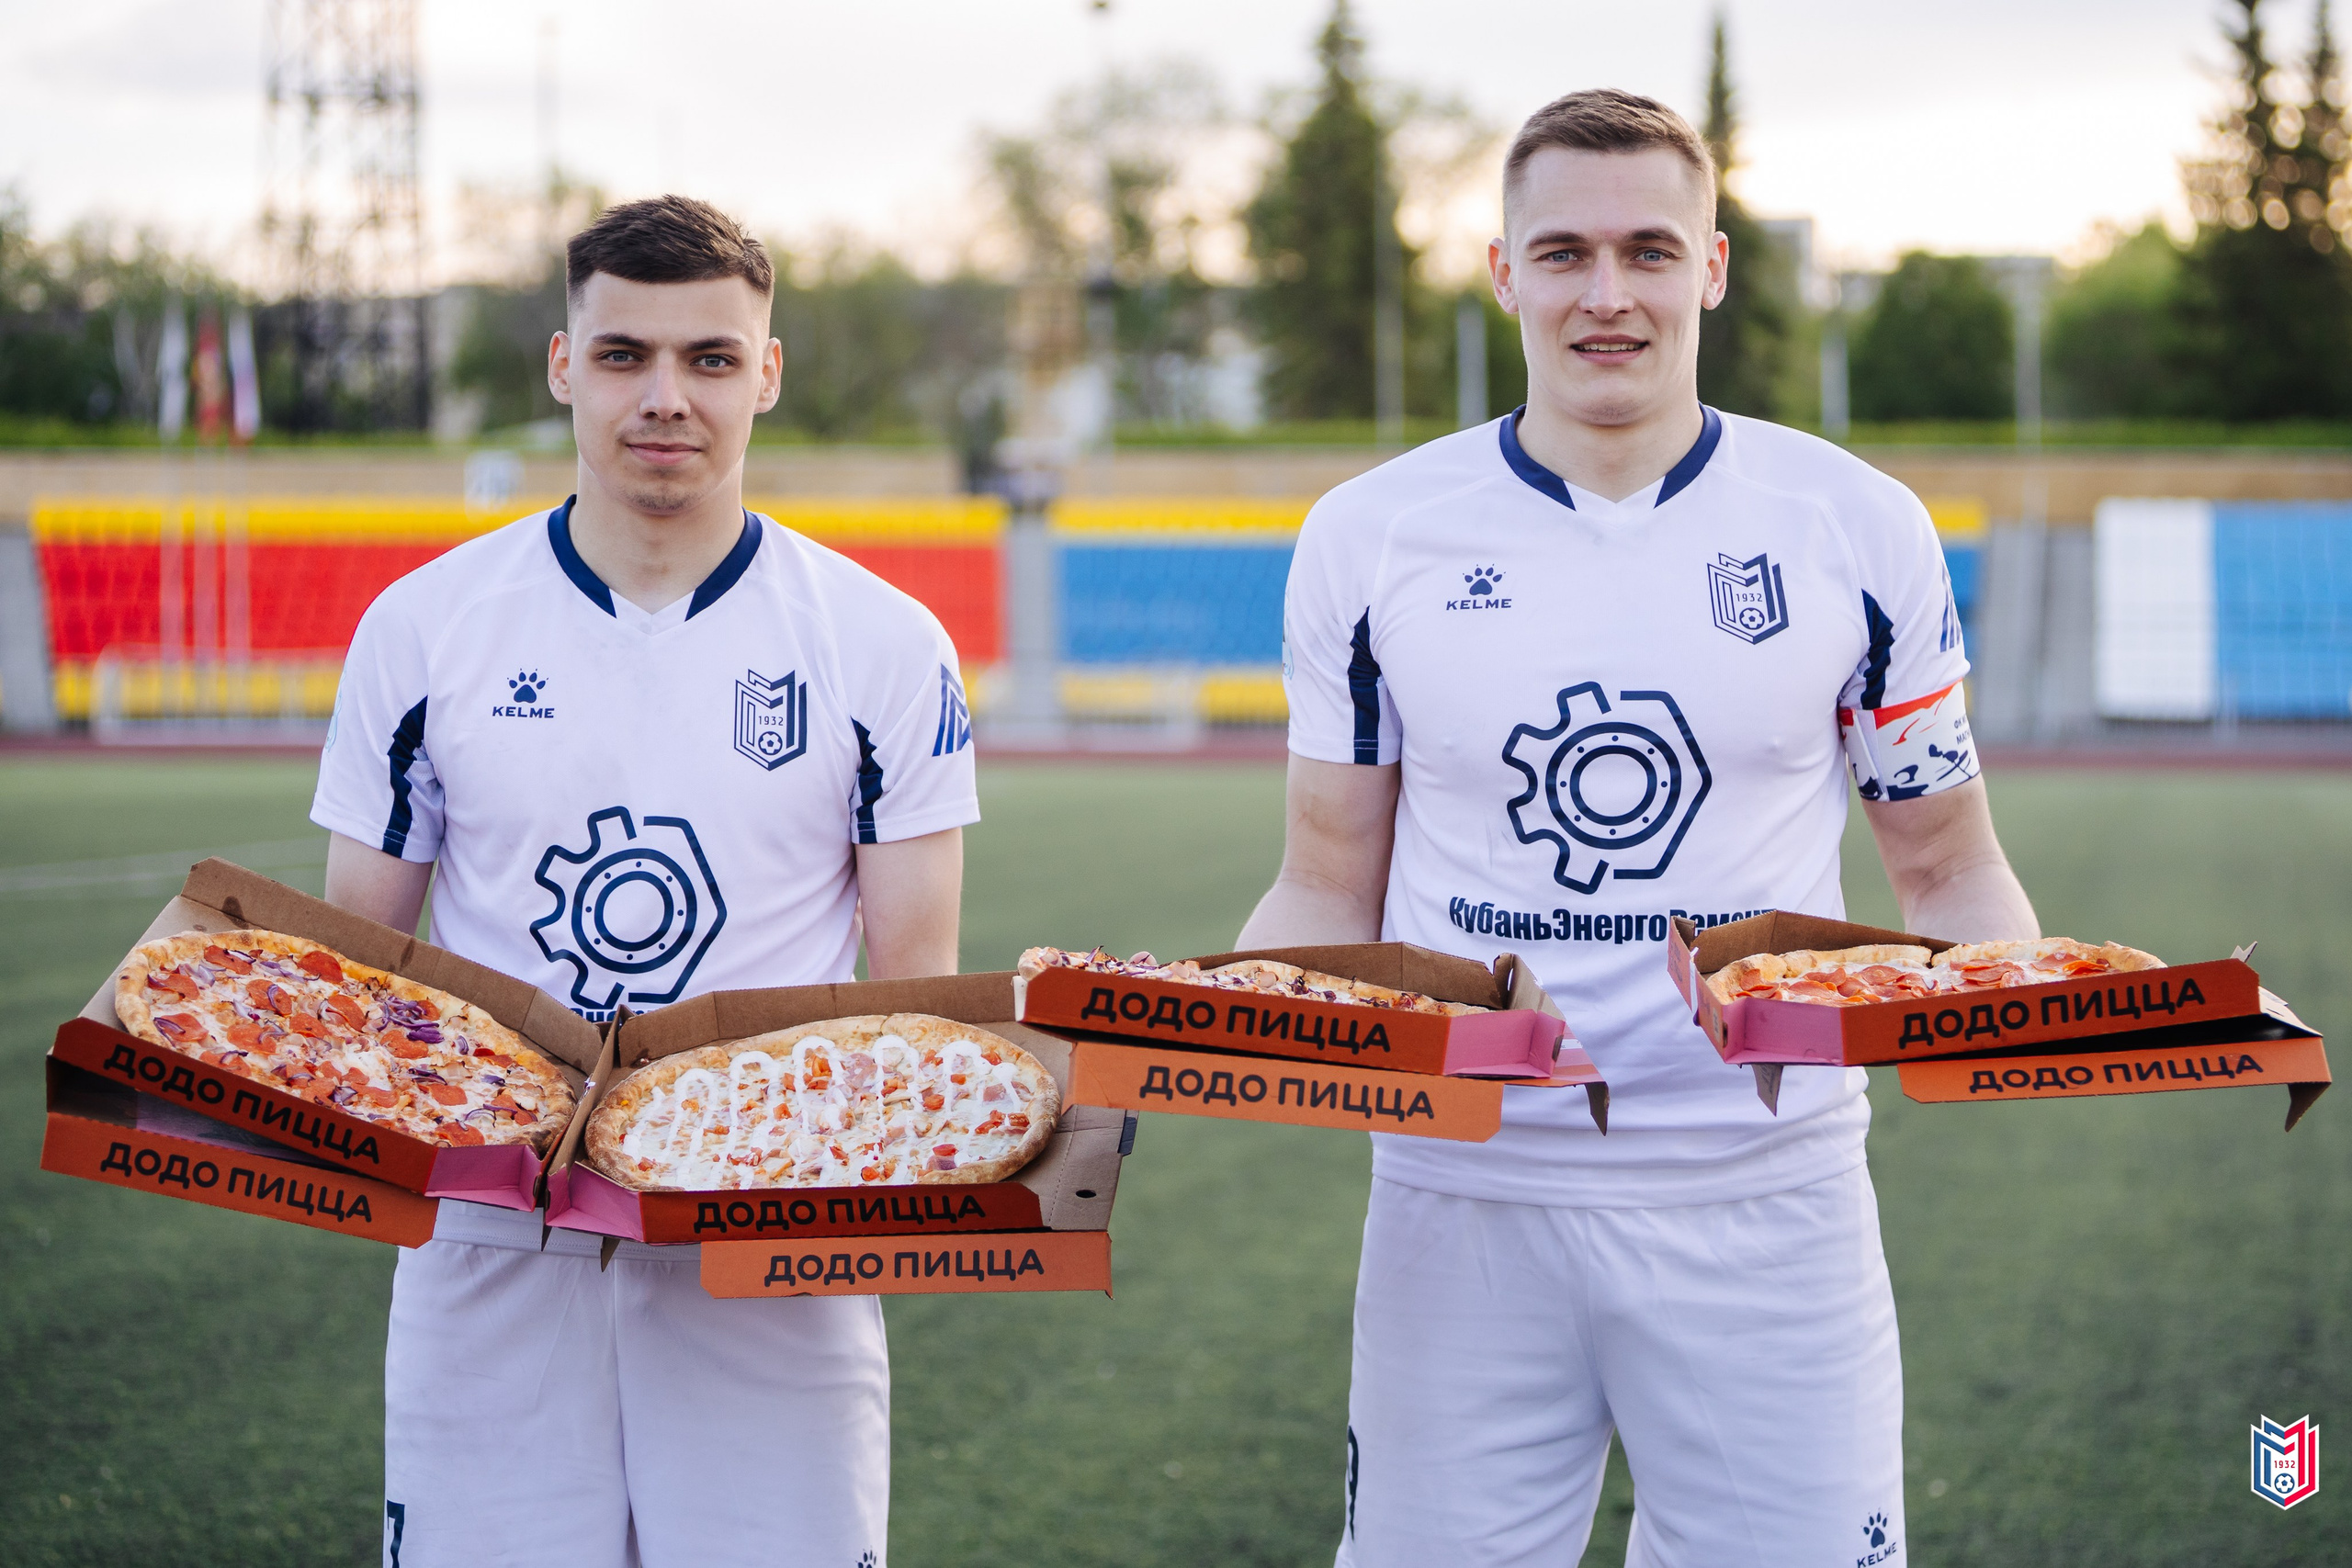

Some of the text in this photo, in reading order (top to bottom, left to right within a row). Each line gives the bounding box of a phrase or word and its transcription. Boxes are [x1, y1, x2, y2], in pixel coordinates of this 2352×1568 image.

[1445, 598, 1512, 611] KELME
[1736, 592, 1763, 603] 1932
[492, 705, 555, 719] KELME
[758, 716, 784, 727] 1932
[1081, 987, 1391, 1055] ДОДО ПИЦЦА
[1899, 977, 2205, 1049] ДОДО ПИЦЦА
[1970, 1055, 2263, 1093] ДОДО ПИЦЦА
[103, 1043, 380, 1165] ДОДО ПИЦЦА
[1139, 1066, 1434, 1122] ДОДО ПИЦЦА
[99, 1142, 372, 1223] ДОДО ПИЦЦА
[693, 1194, 987, 1234] ДОДО ПИЦЦА
[764, 1248, 1045, 1286] ДОДО ПИЦЦА
[1856, 1541, 1897, 1568] KELME
